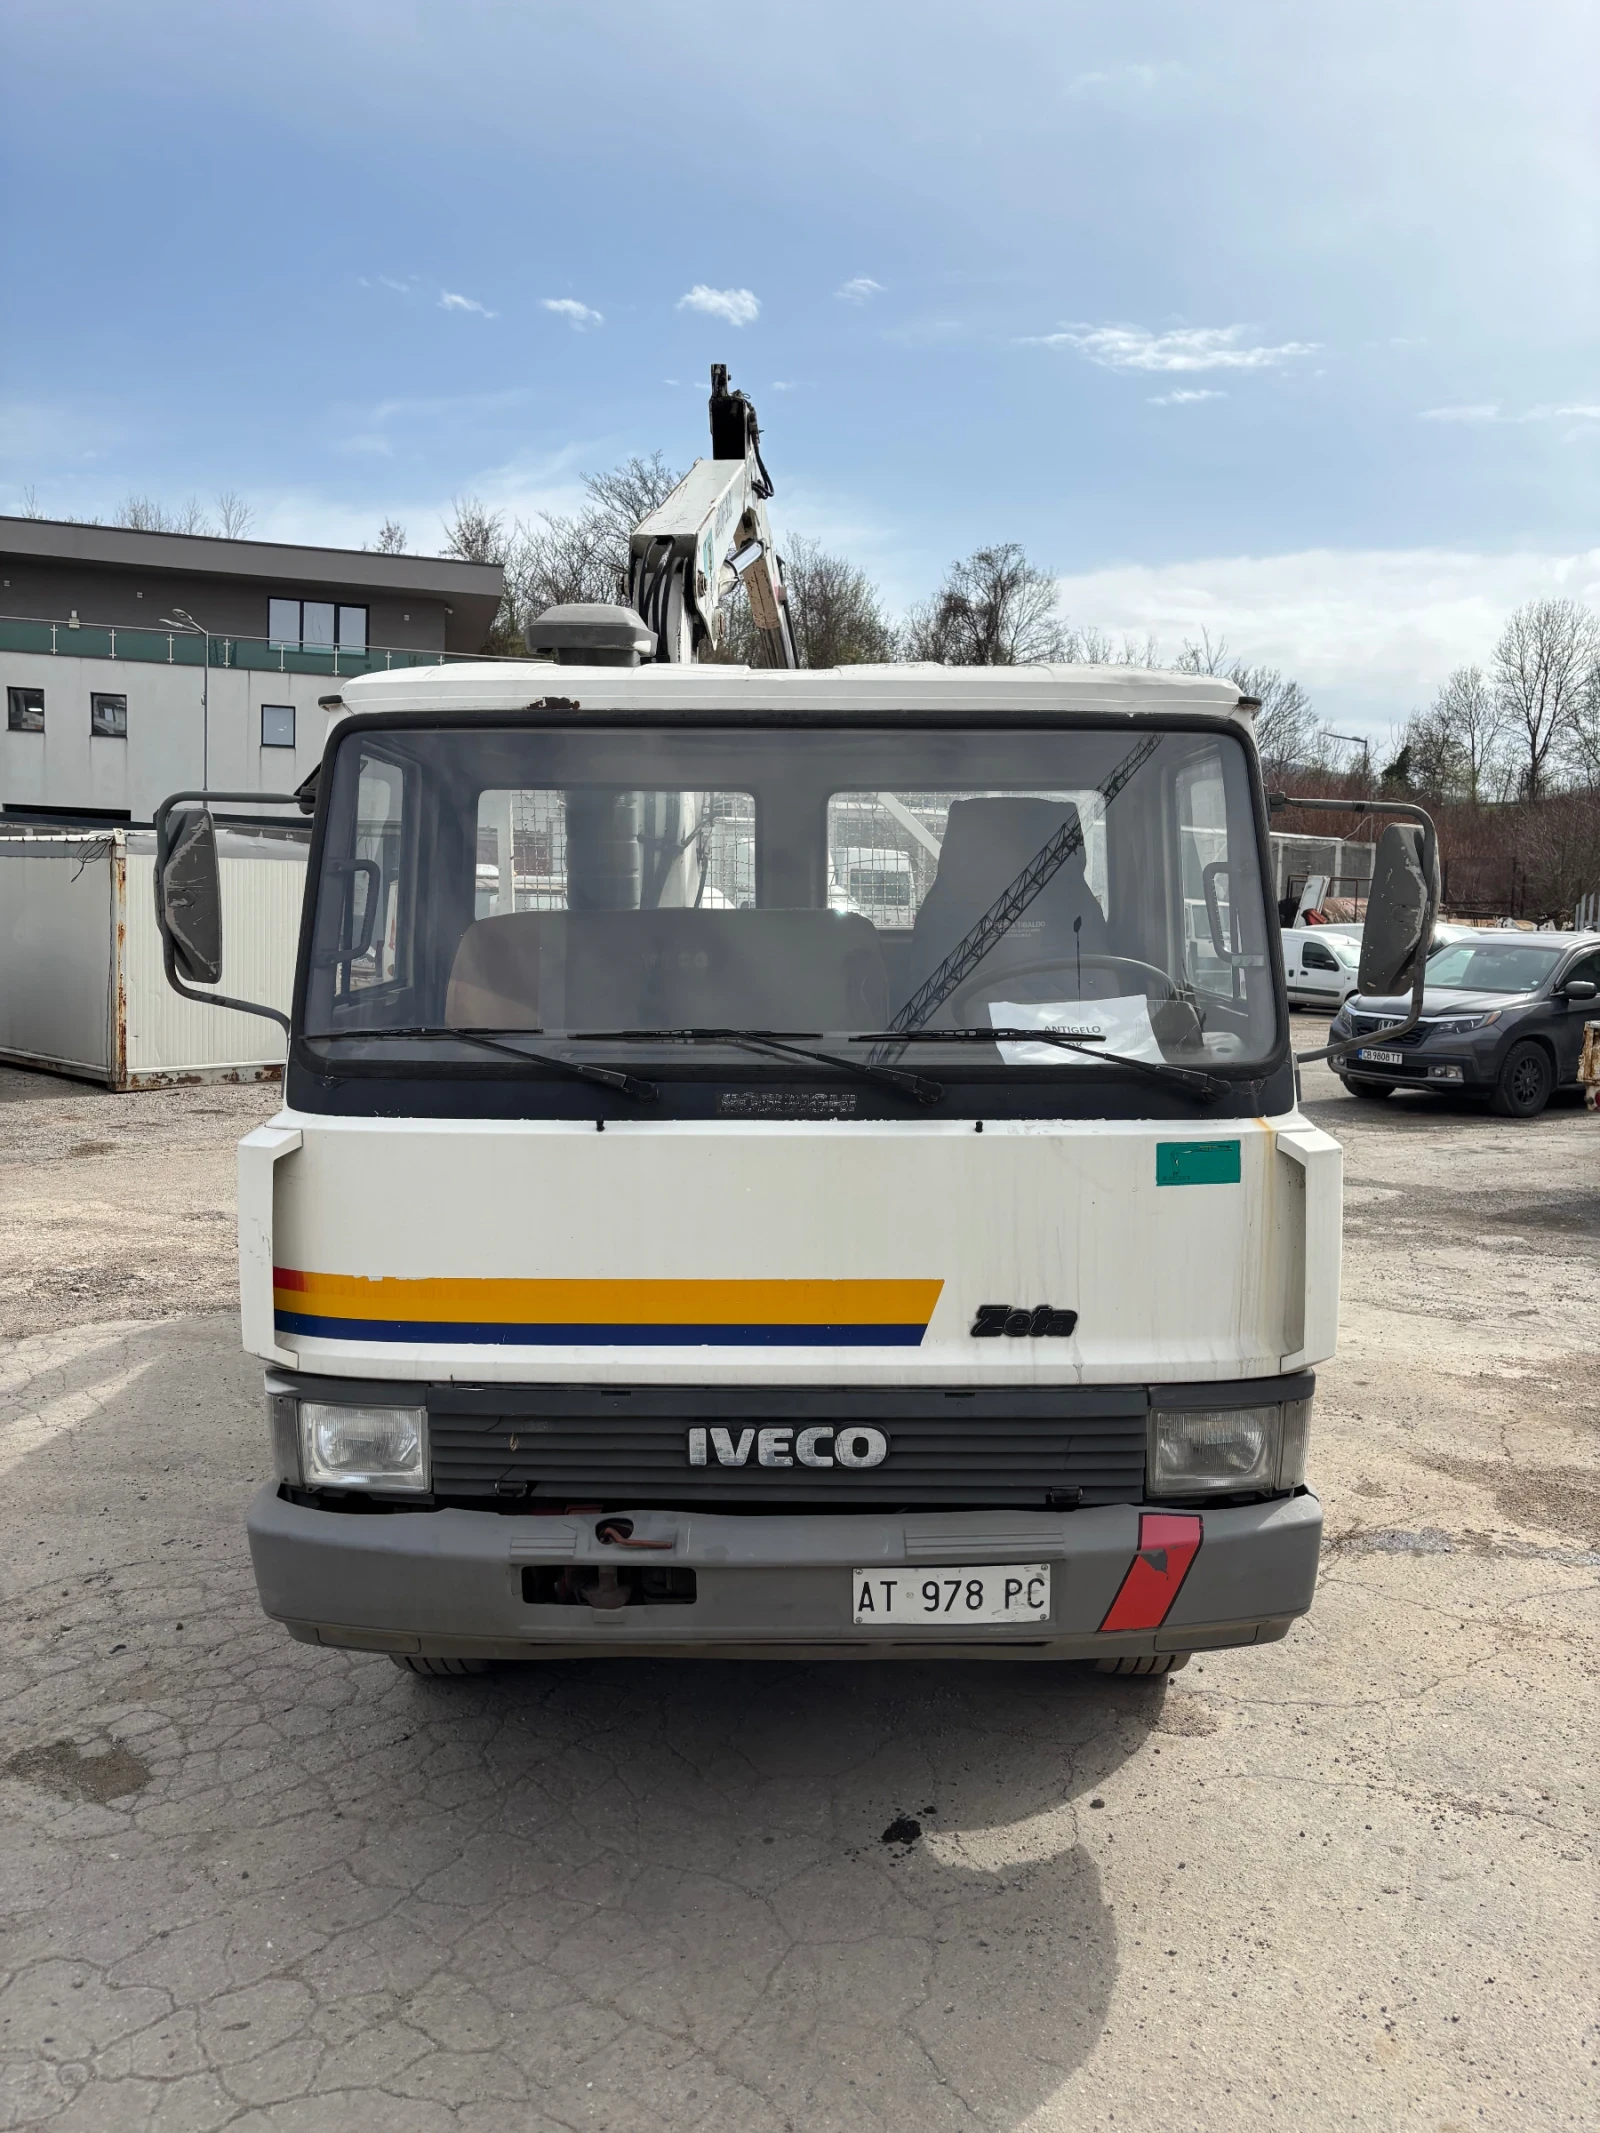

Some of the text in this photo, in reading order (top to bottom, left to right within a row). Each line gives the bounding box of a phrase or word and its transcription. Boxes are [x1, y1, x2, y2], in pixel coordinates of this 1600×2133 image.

[1044, 1025, 1101, 1034] ANTIGELO
[1391, 1053, 1401, 1062] TT
[688, 1426, 888, 1467] IVECO
[857, 1578, 1046, 1612] AT 978 PC
